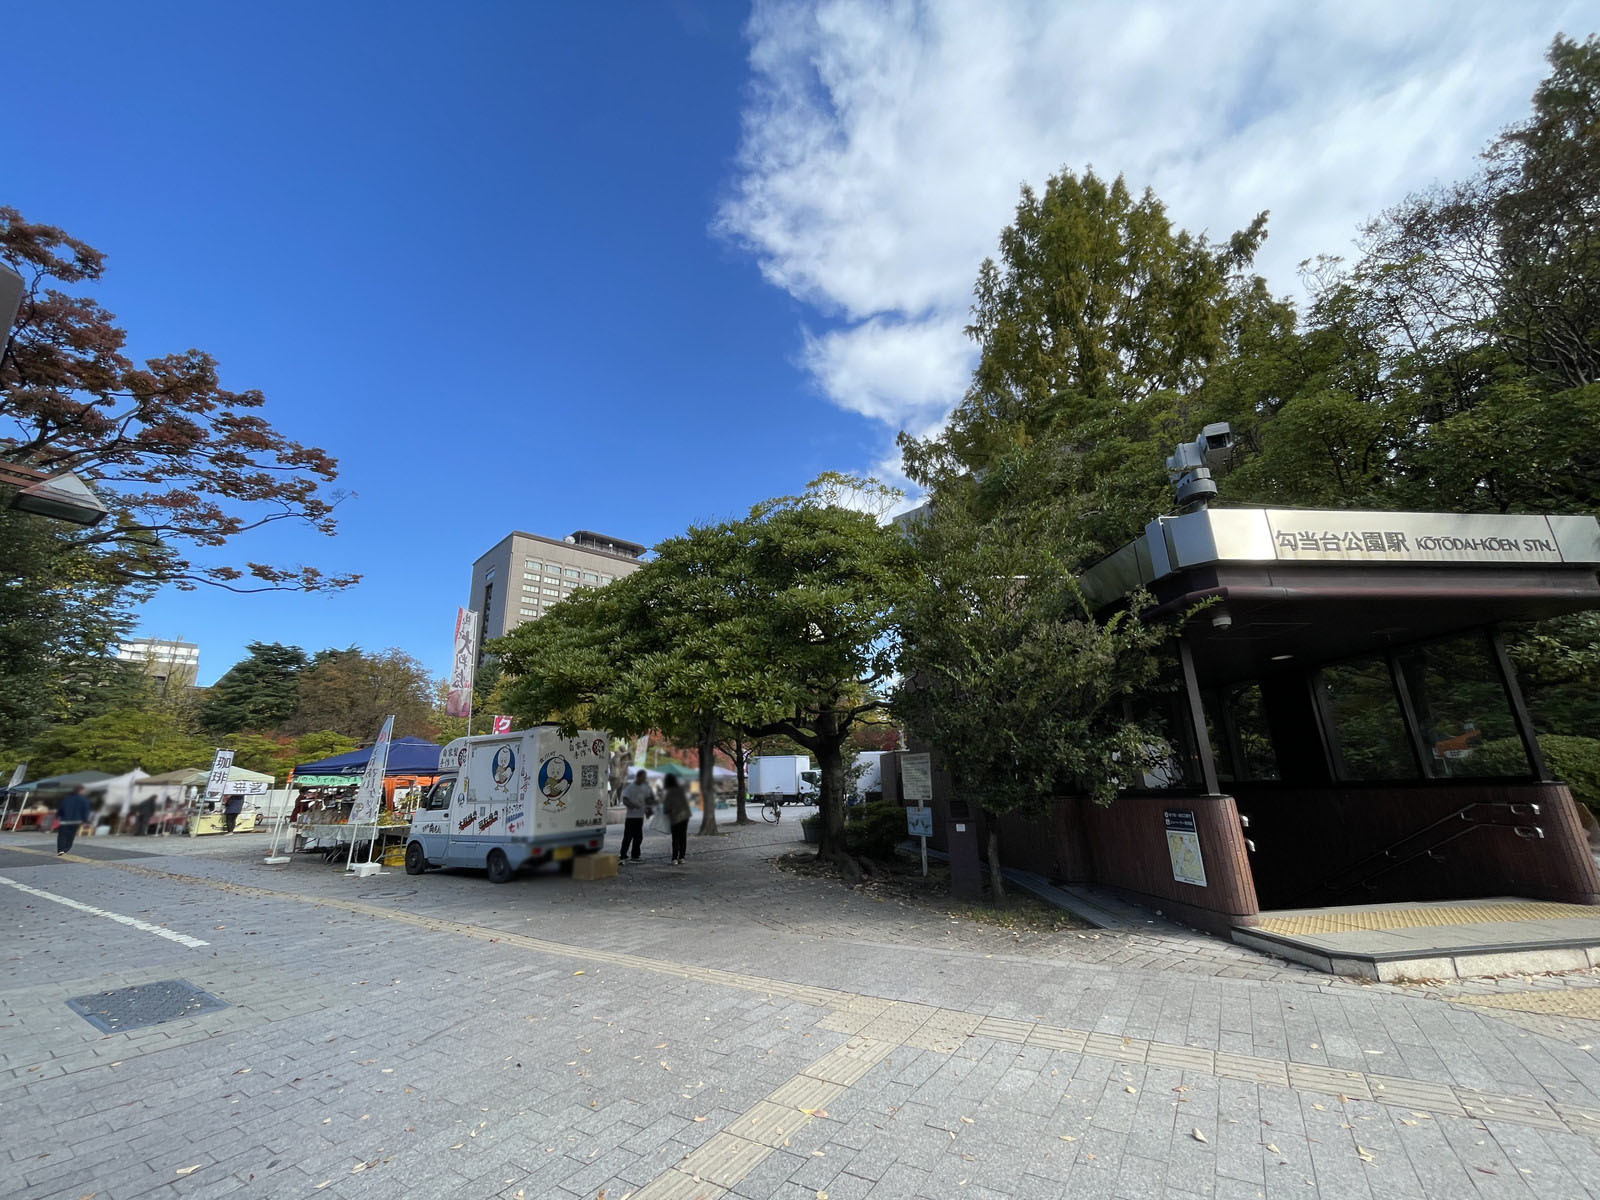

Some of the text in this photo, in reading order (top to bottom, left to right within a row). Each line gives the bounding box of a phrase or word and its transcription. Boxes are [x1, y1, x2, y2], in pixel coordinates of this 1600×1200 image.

[1276, 529, 1410, 553] 勾当台公園駅
[1523, 538, 1556, 552] STN.
[211, 756, 231, 785] 珈琲
